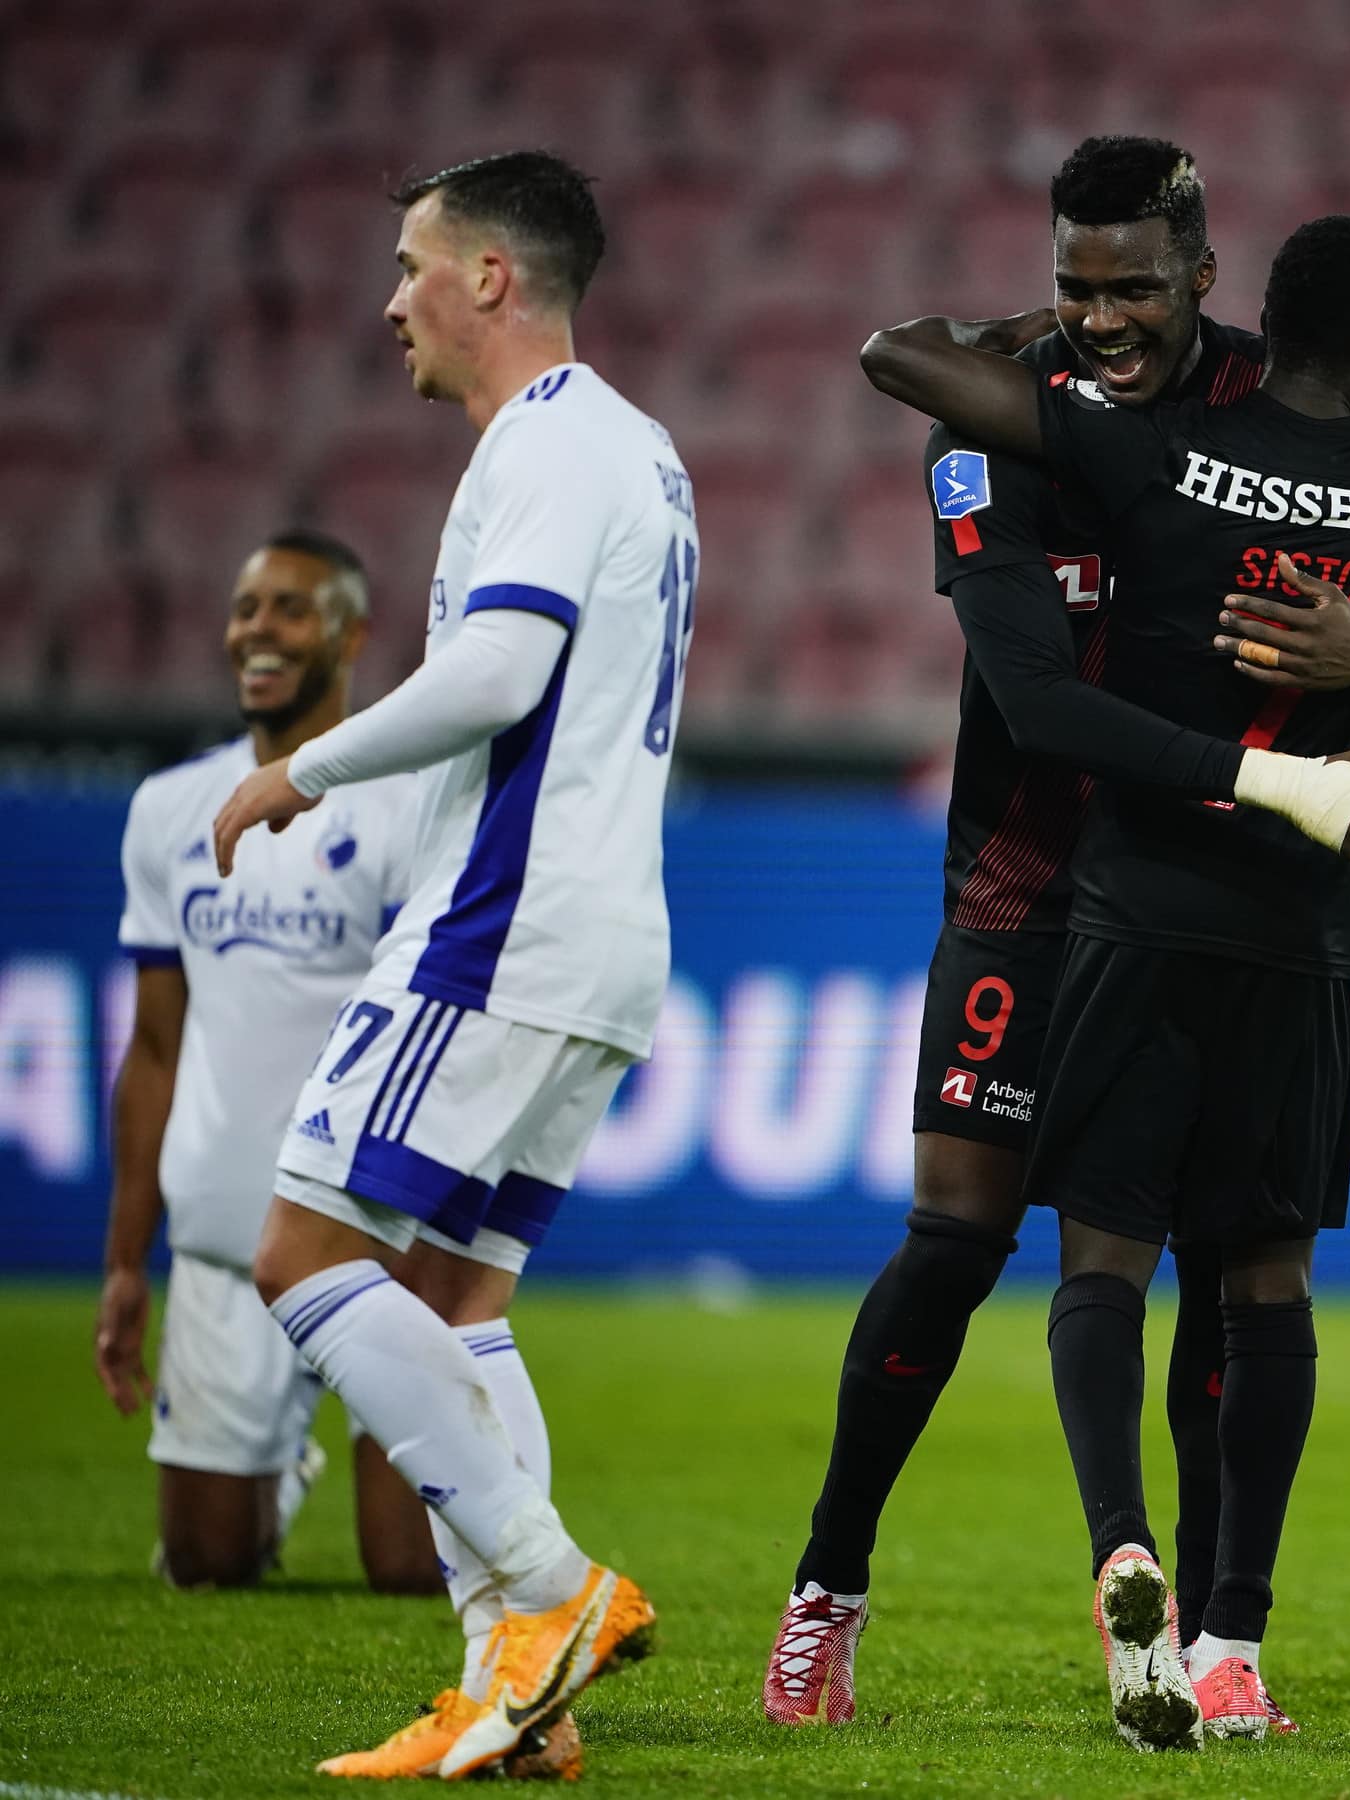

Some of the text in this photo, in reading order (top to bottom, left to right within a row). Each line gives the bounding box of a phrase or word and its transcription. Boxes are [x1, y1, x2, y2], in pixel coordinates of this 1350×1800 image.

[943, 494, 977, 509] SUPERLIGA
[182, 886, 346, 952] Carlsberg
[957, 975, 1015, 1062] 9
